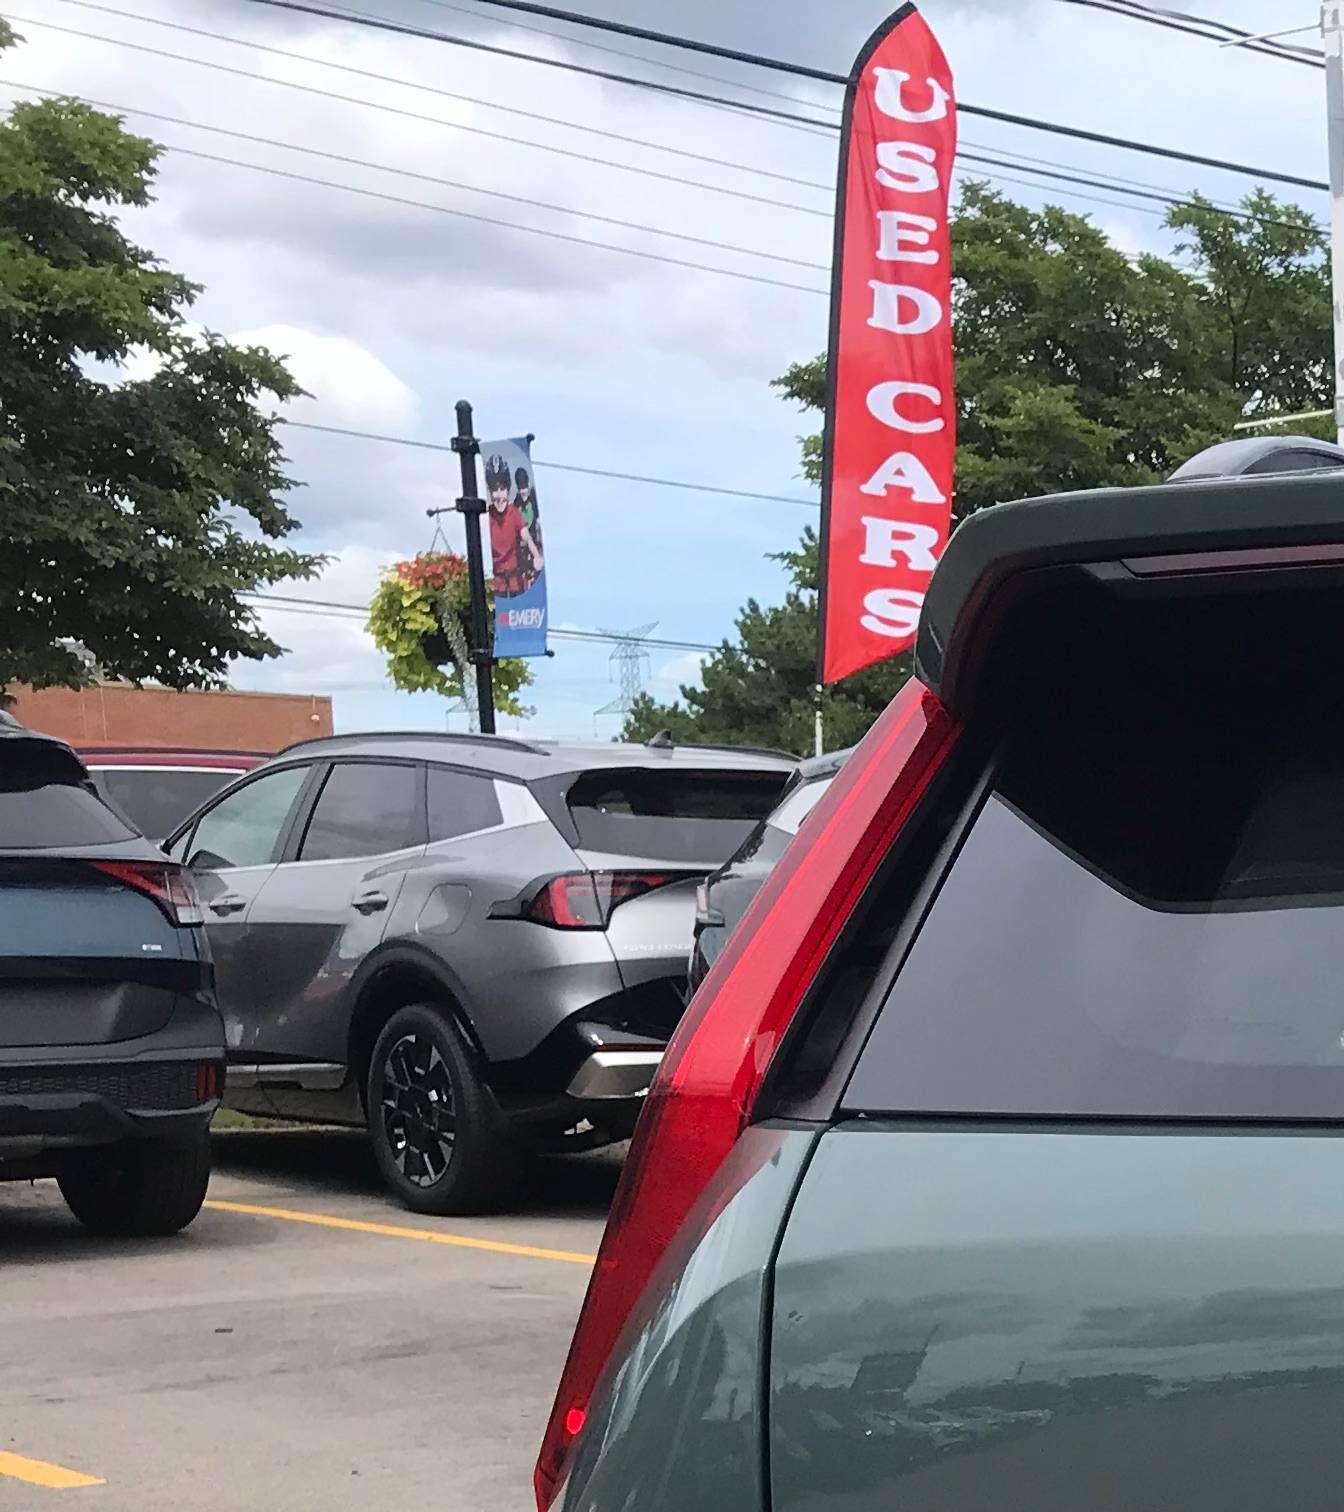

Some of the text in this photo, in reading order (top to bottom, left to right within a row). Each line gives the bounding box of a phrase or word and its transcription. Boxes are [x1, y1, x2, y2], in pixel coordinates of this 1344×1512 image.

[859, 67, 950, 638] USED CARS
[508, 608, 545, 629] EMERY
